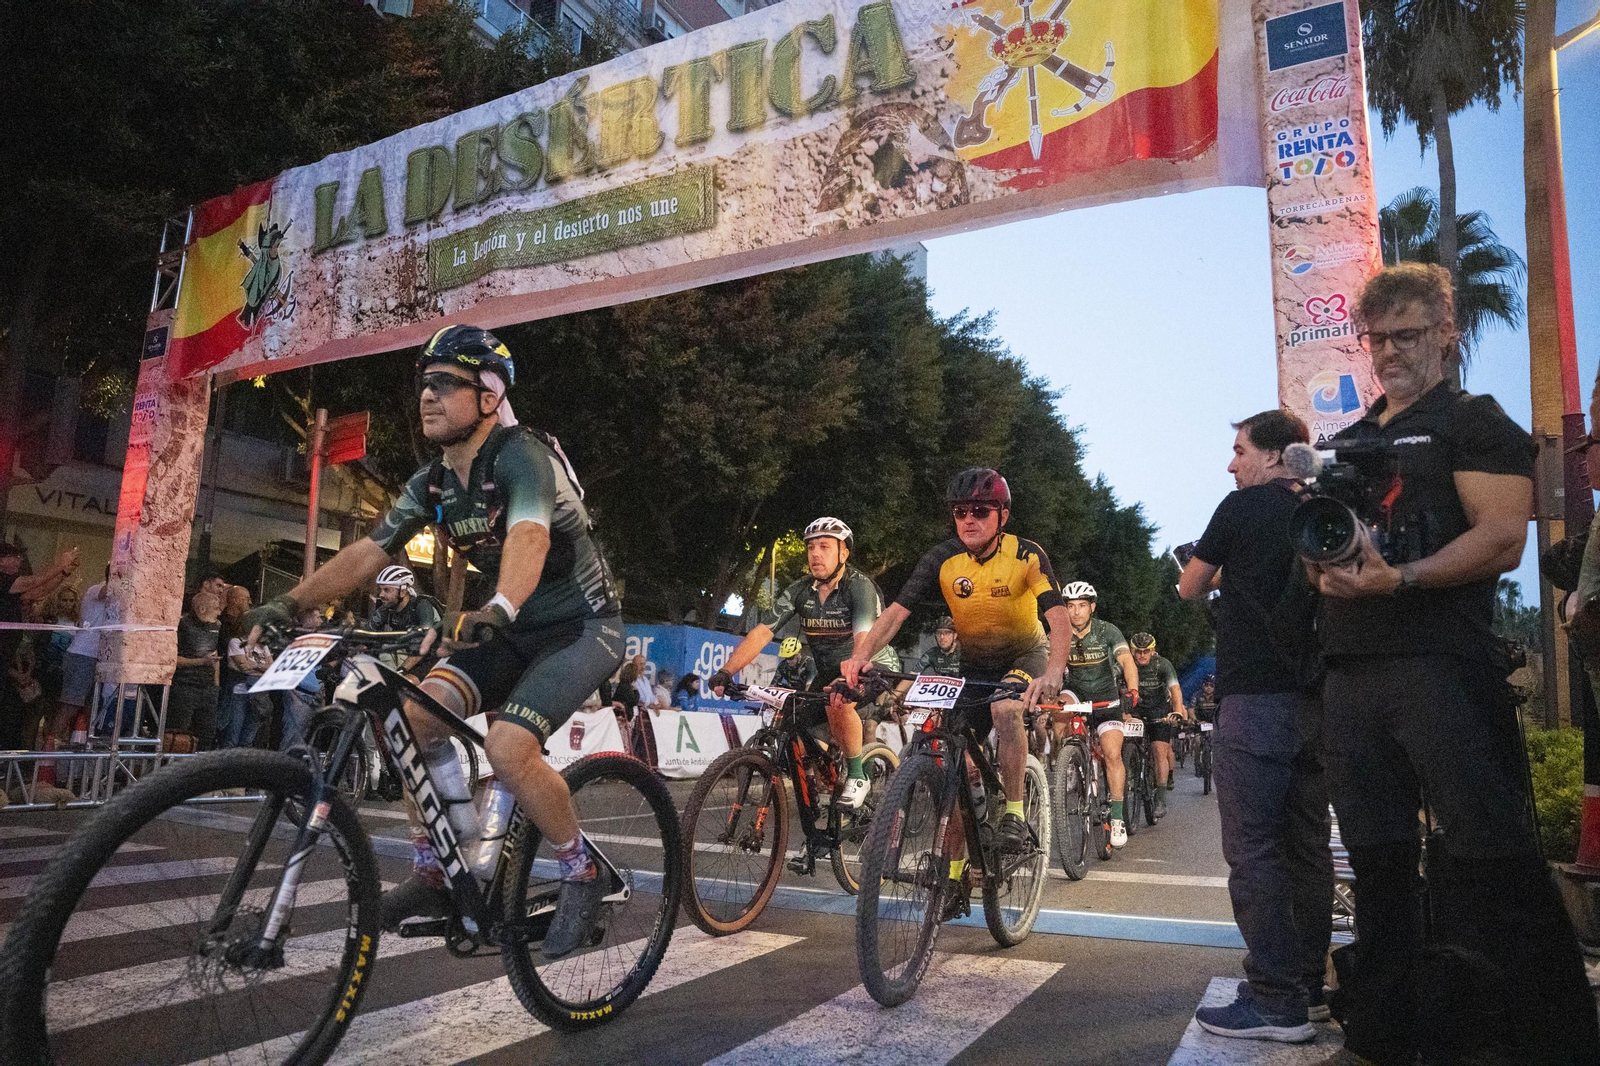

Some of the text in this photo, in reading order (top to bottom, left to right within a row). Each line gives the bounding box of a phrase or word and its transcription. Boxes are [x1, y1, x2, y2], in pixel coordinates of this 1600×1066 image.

[1284, 33, 1328, 51] SENATOR
[312, 1, 917, 257] LA DESÉRTICA
[1277, 118, 1349, 140] GRUPO
[1278, 131, 1354, 159] RENTA
[1279, 150, 1355, 179] TODO
[453, 197, 678, 267] La Legión y el desierto nos une
[134, 400, 156, 411] RENTA
[918, 684, 958, 698] 5408
[505, 703, 519, 714] LA
[336, 933, 371, 1023] MAXXIS
[570, 1004, 613, 1021] MAXXIS
